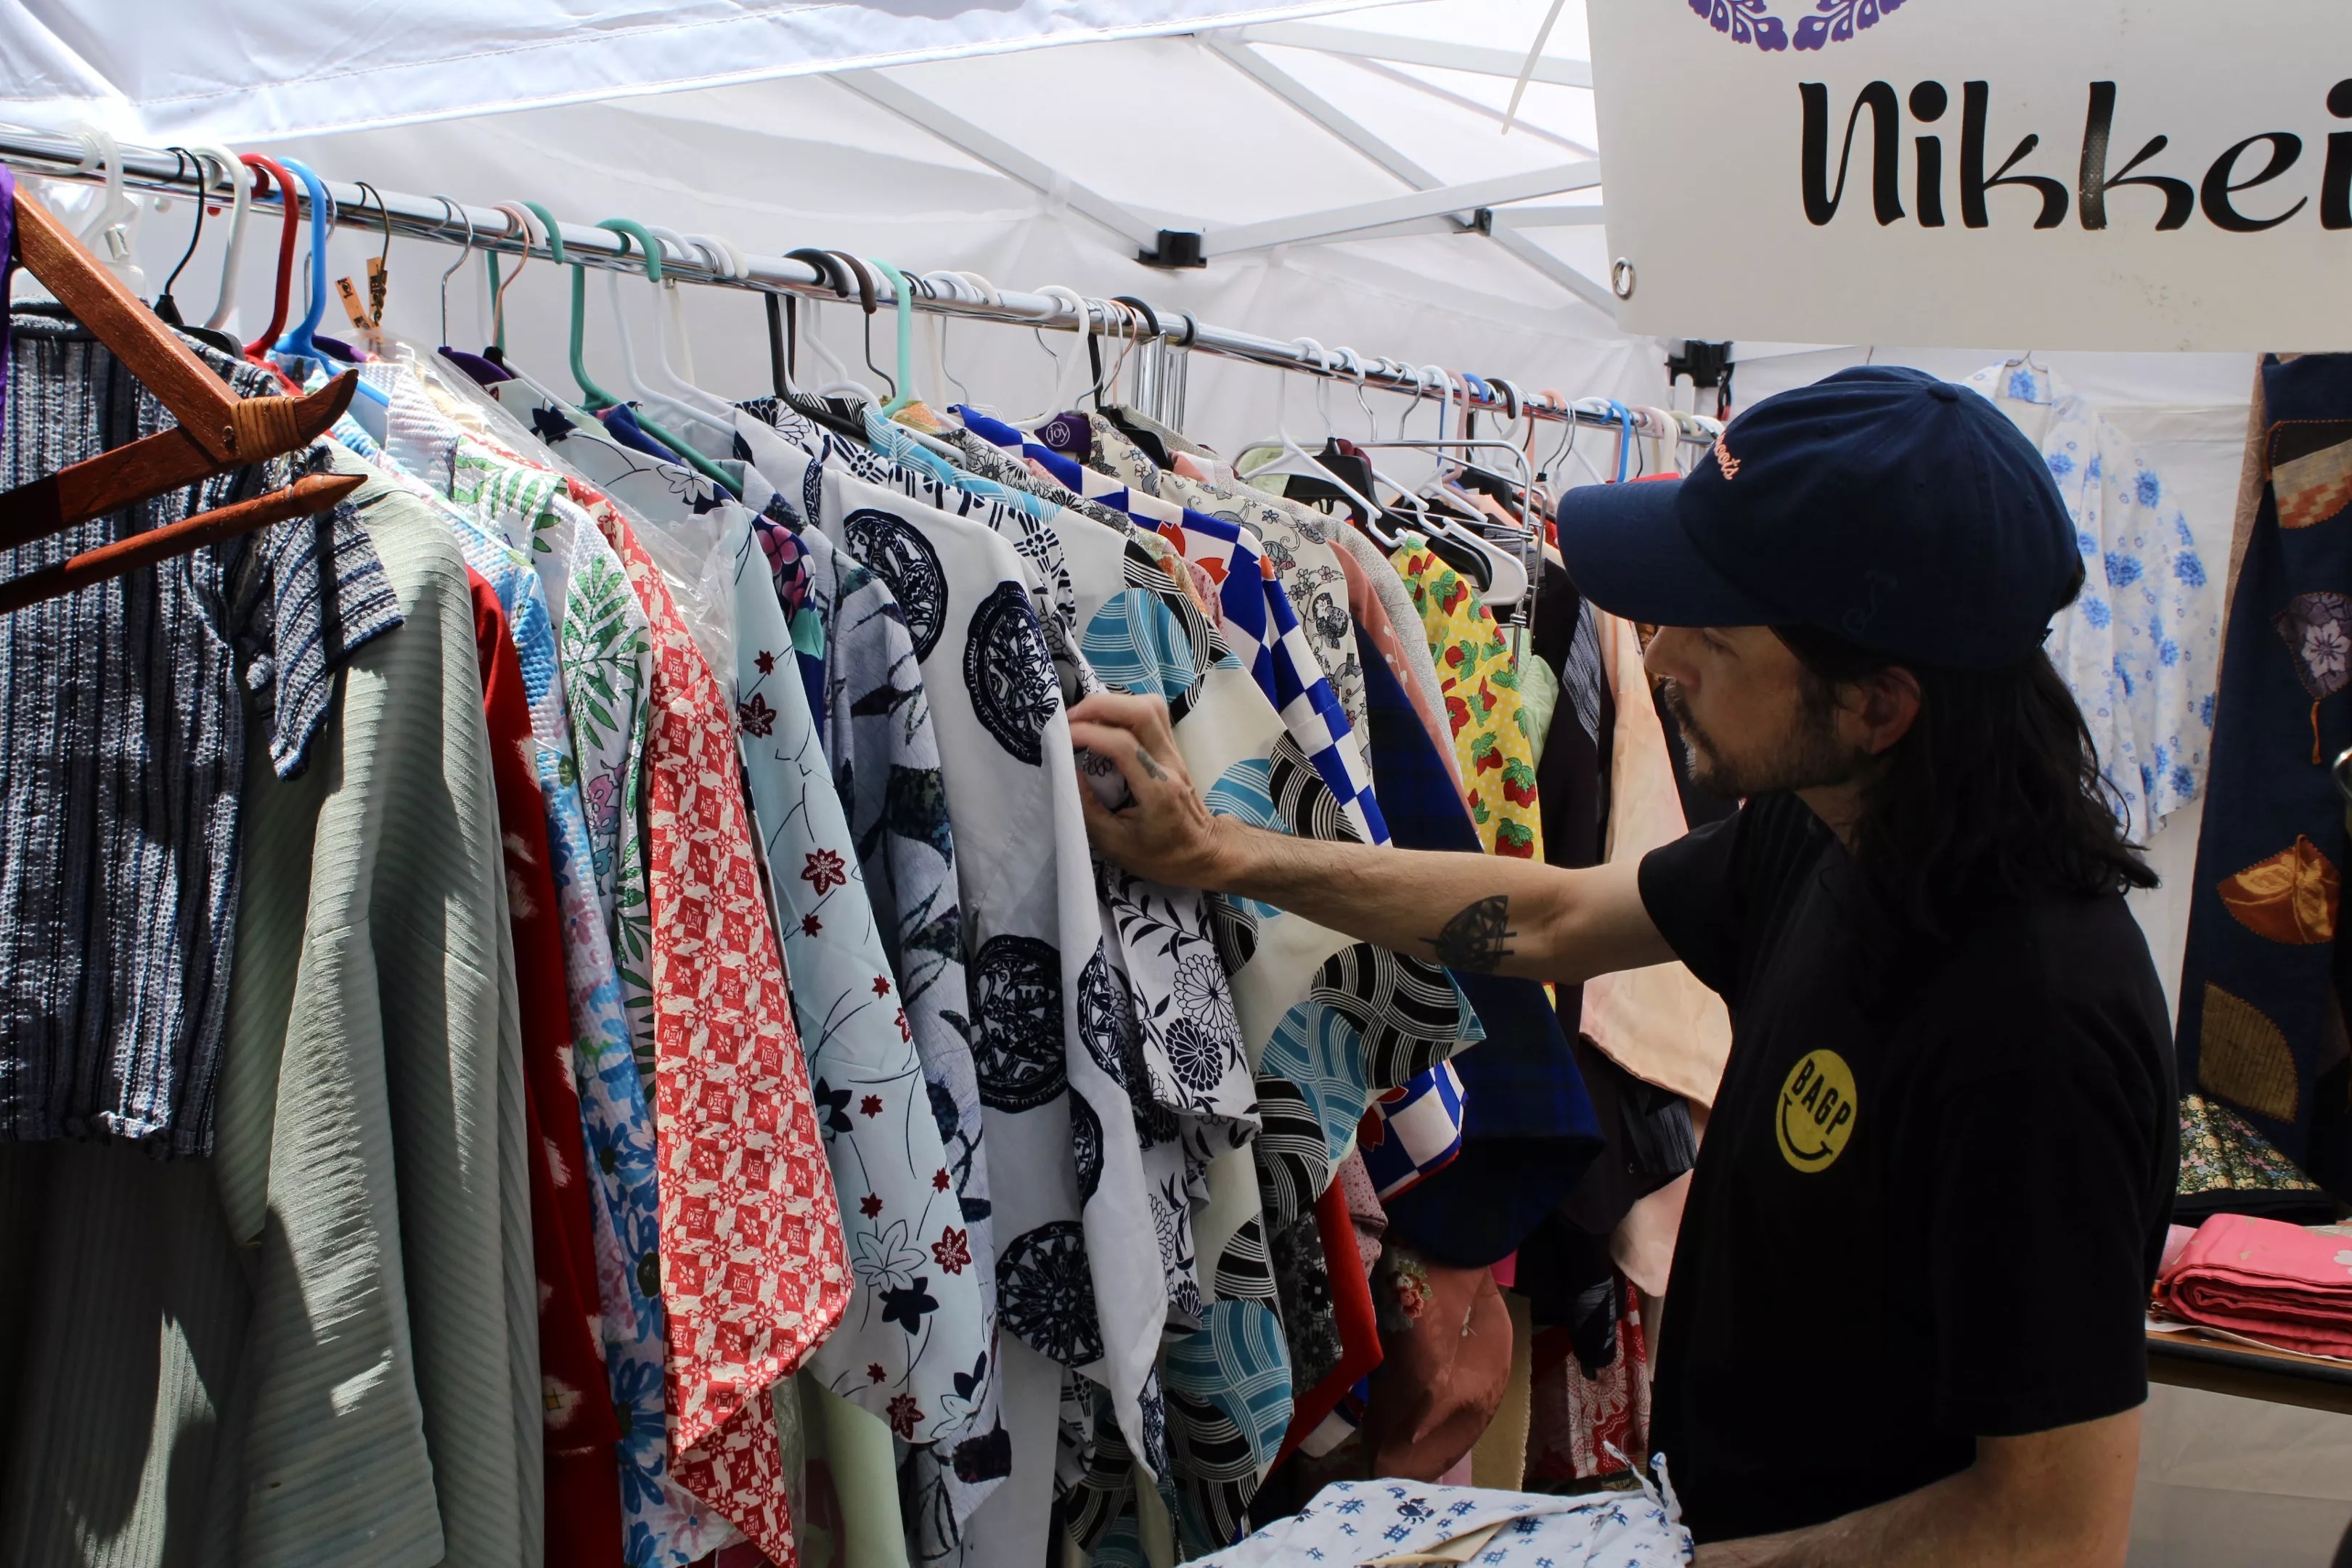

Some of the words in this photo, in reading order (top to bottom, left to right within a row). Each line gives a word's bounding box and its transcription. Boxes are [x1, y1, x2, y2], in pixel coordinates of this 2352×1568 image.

[1799, 79, 2352, 232] Nikkei
[1048, 424, 1069, 444] joy
[1792, 1058, 1851, 1135] BAGP
